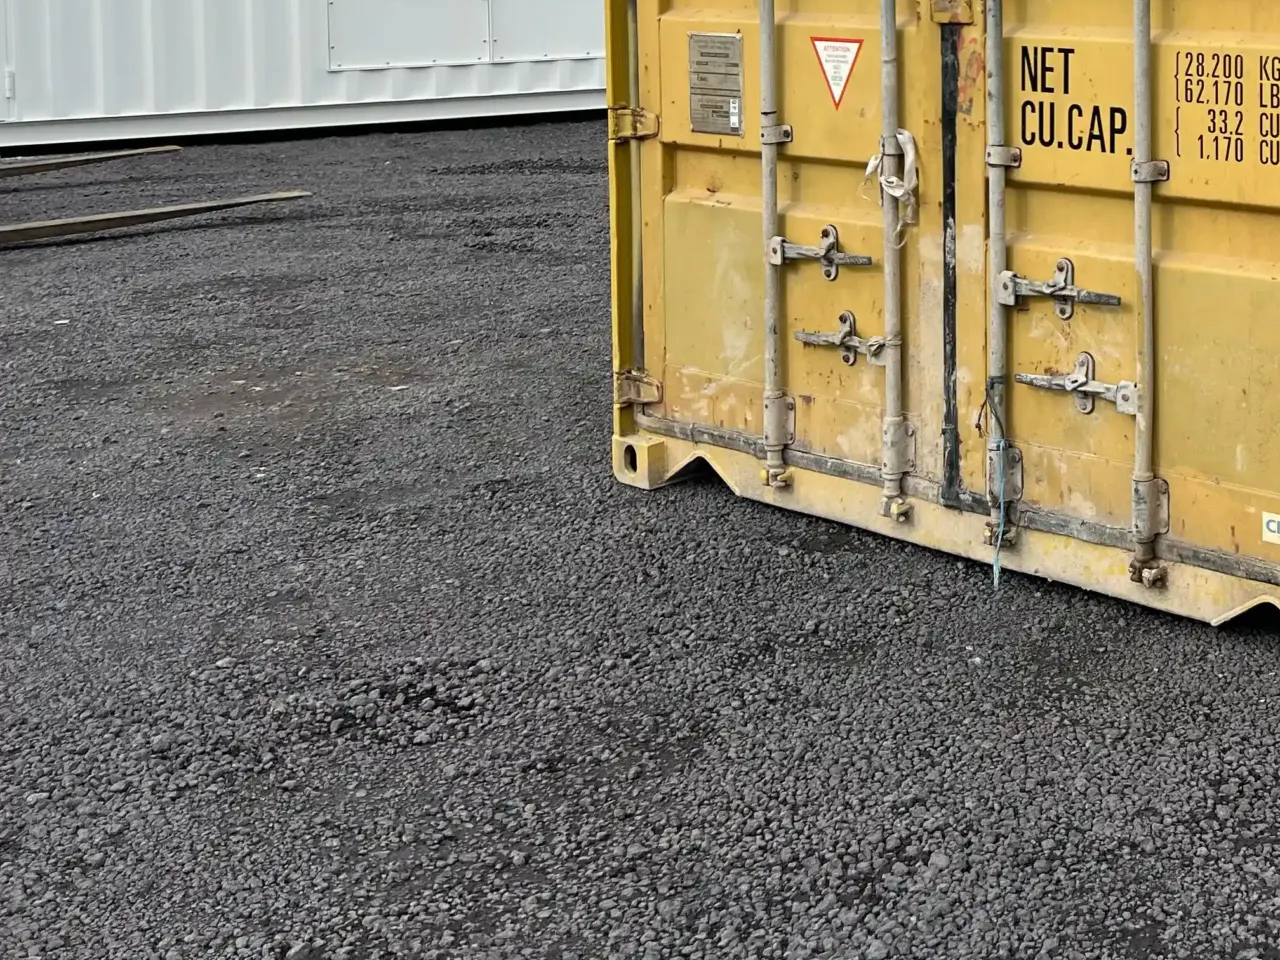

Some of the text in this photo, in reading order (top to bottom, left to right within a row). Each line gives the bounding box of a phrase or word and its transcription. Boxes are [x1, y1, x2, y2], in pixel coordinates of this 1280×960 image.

[1021, 45, 1075, 95] NET
[1021, 100, 1133, 156] CU.CAP.
[1207, 109, 1244, 136] 33.2
